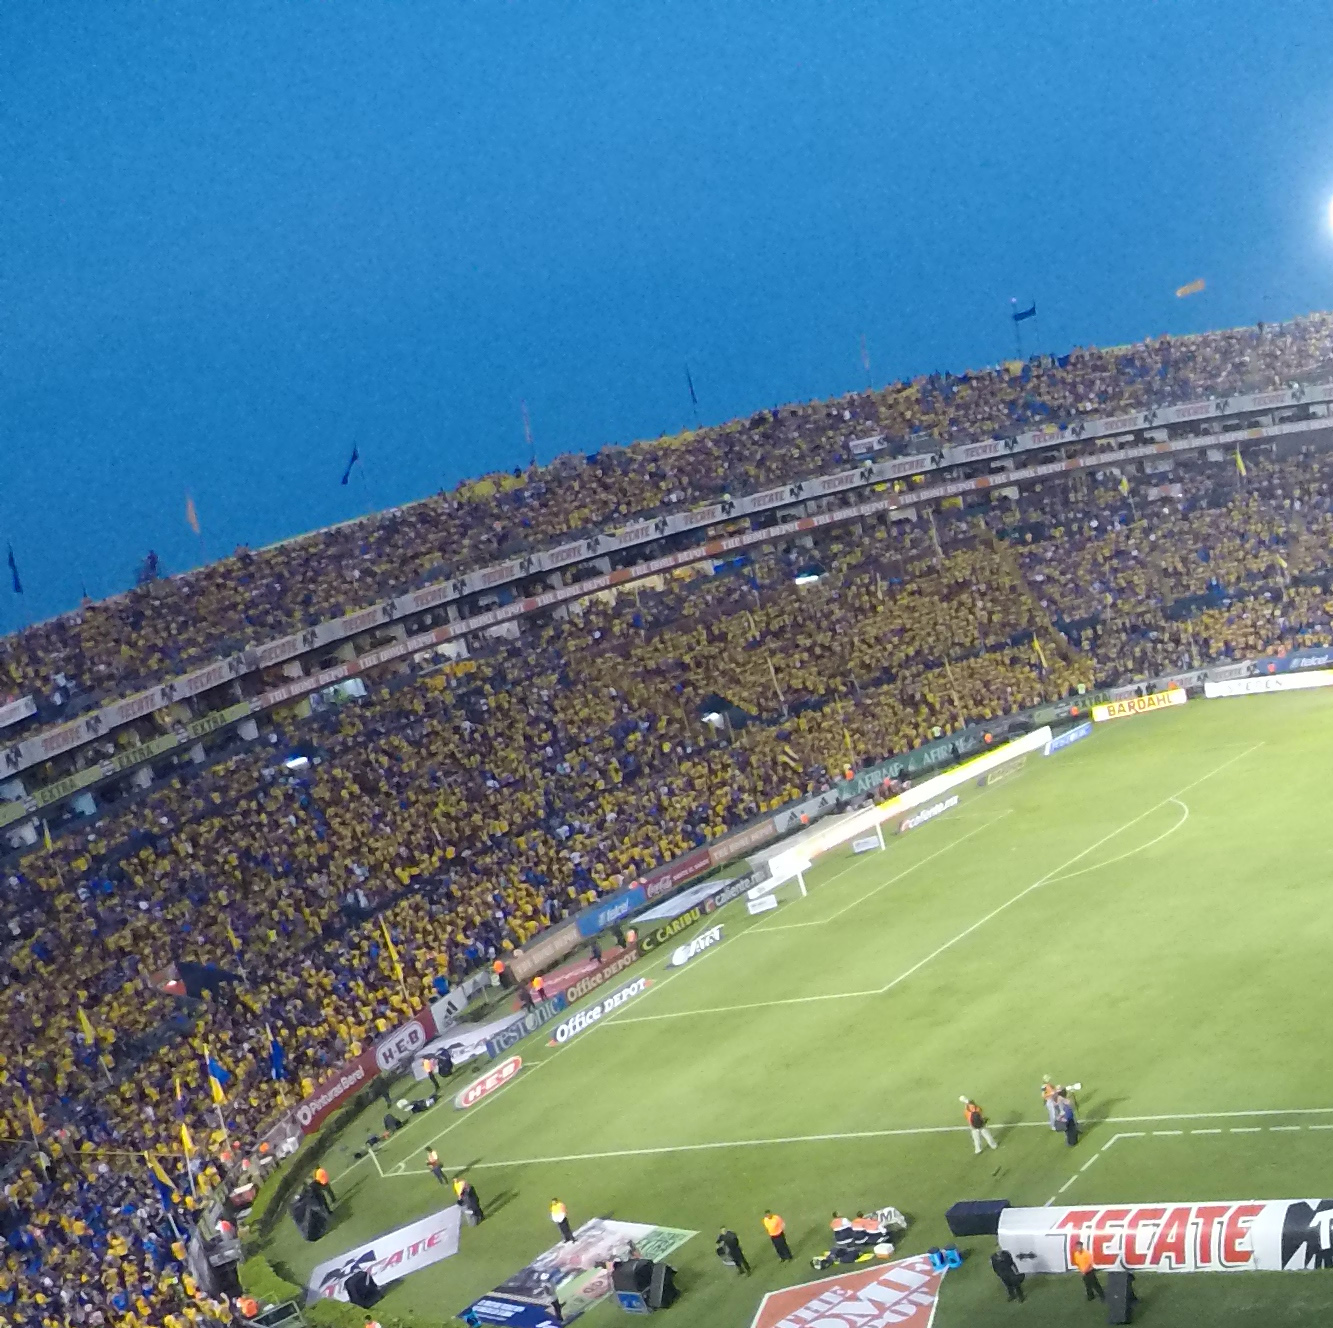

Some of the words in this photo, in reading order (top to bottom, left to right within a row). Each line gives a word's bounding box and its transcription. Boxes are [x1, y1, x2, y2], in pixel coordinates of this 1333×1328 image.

[1107, 693, 1172, 717] BARDAHL
[656, 908, 700, 943] CARIBU
[566, 974, 603, 1003] Office
[602, 950, 639, 983] DEPOT
[556, 1007, 603, 1043] Office
[603, 978, 647, 1014] DEPOT
[1057, 1204, 1268, 1270] TECATE
